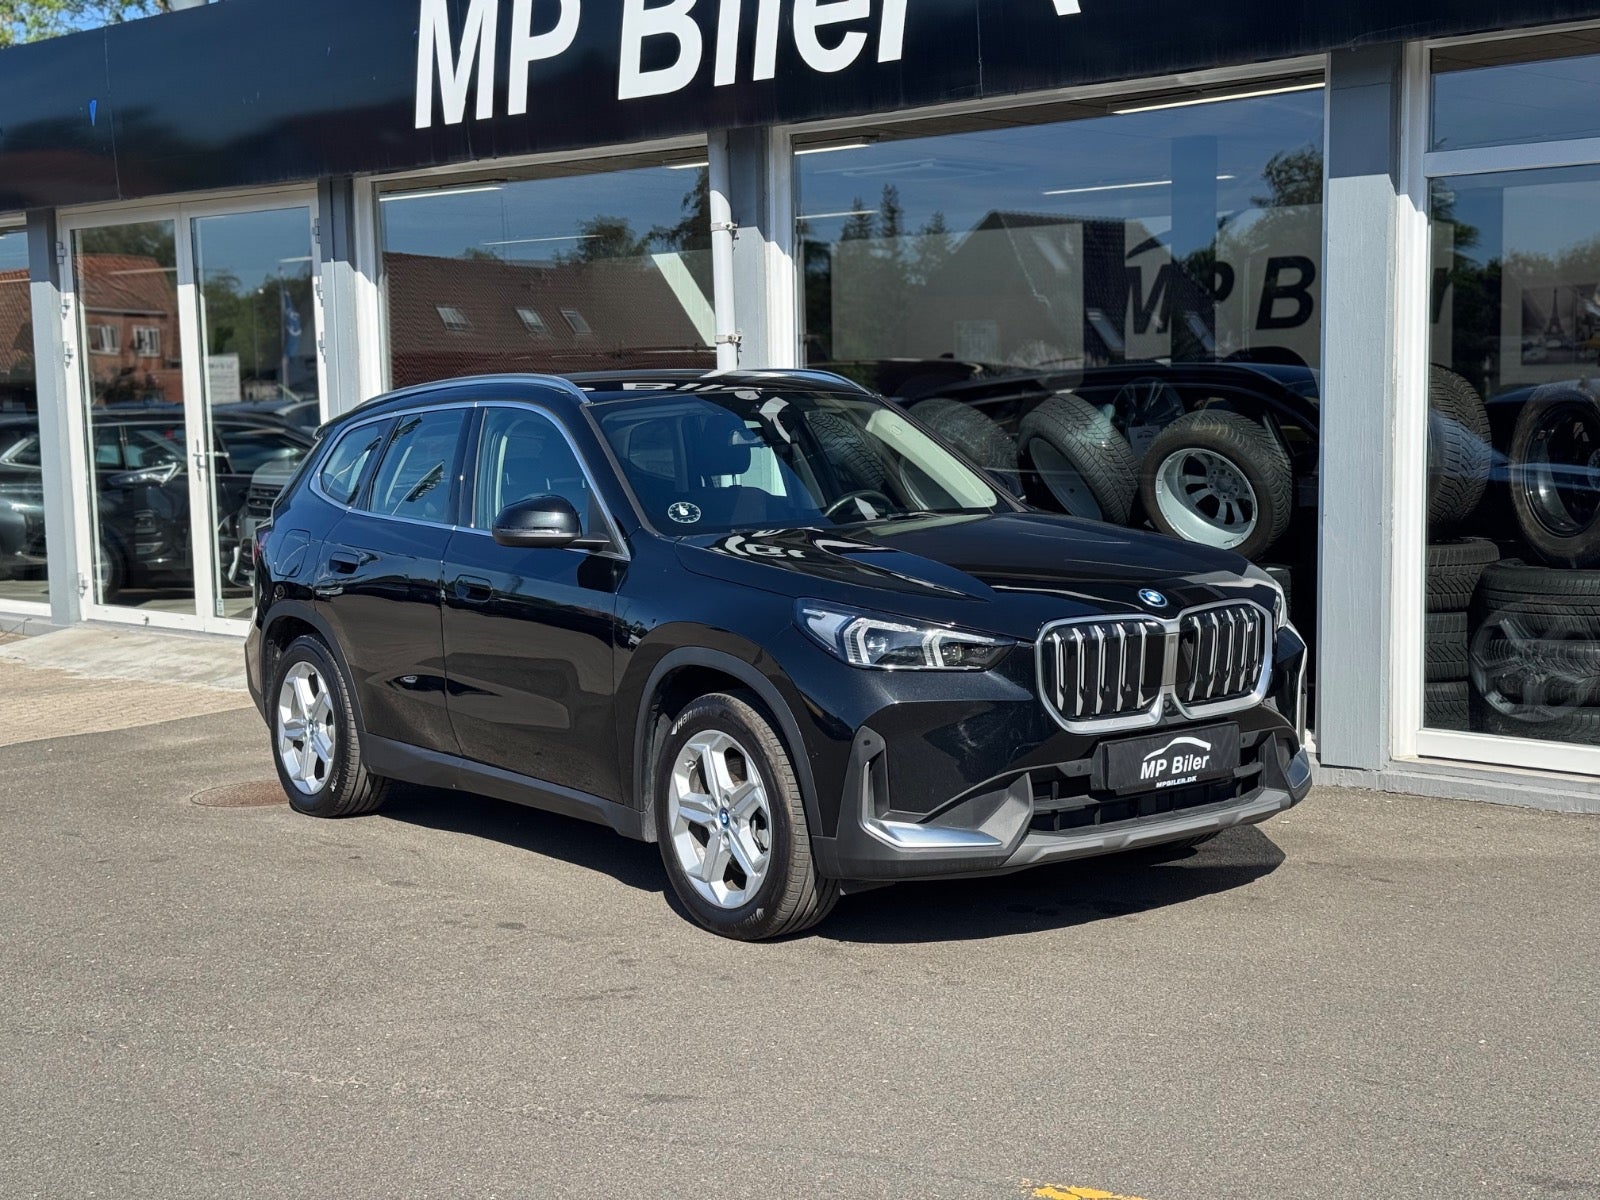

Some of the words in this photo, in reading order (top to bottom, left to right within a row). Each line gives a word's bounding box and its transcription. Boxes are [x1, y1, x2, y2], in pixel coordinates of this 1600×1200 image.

[415, 0, 581, 129] MP
[1140, 759, 1167, 780] MP
[1172, 754, 1210, 774] Biler
